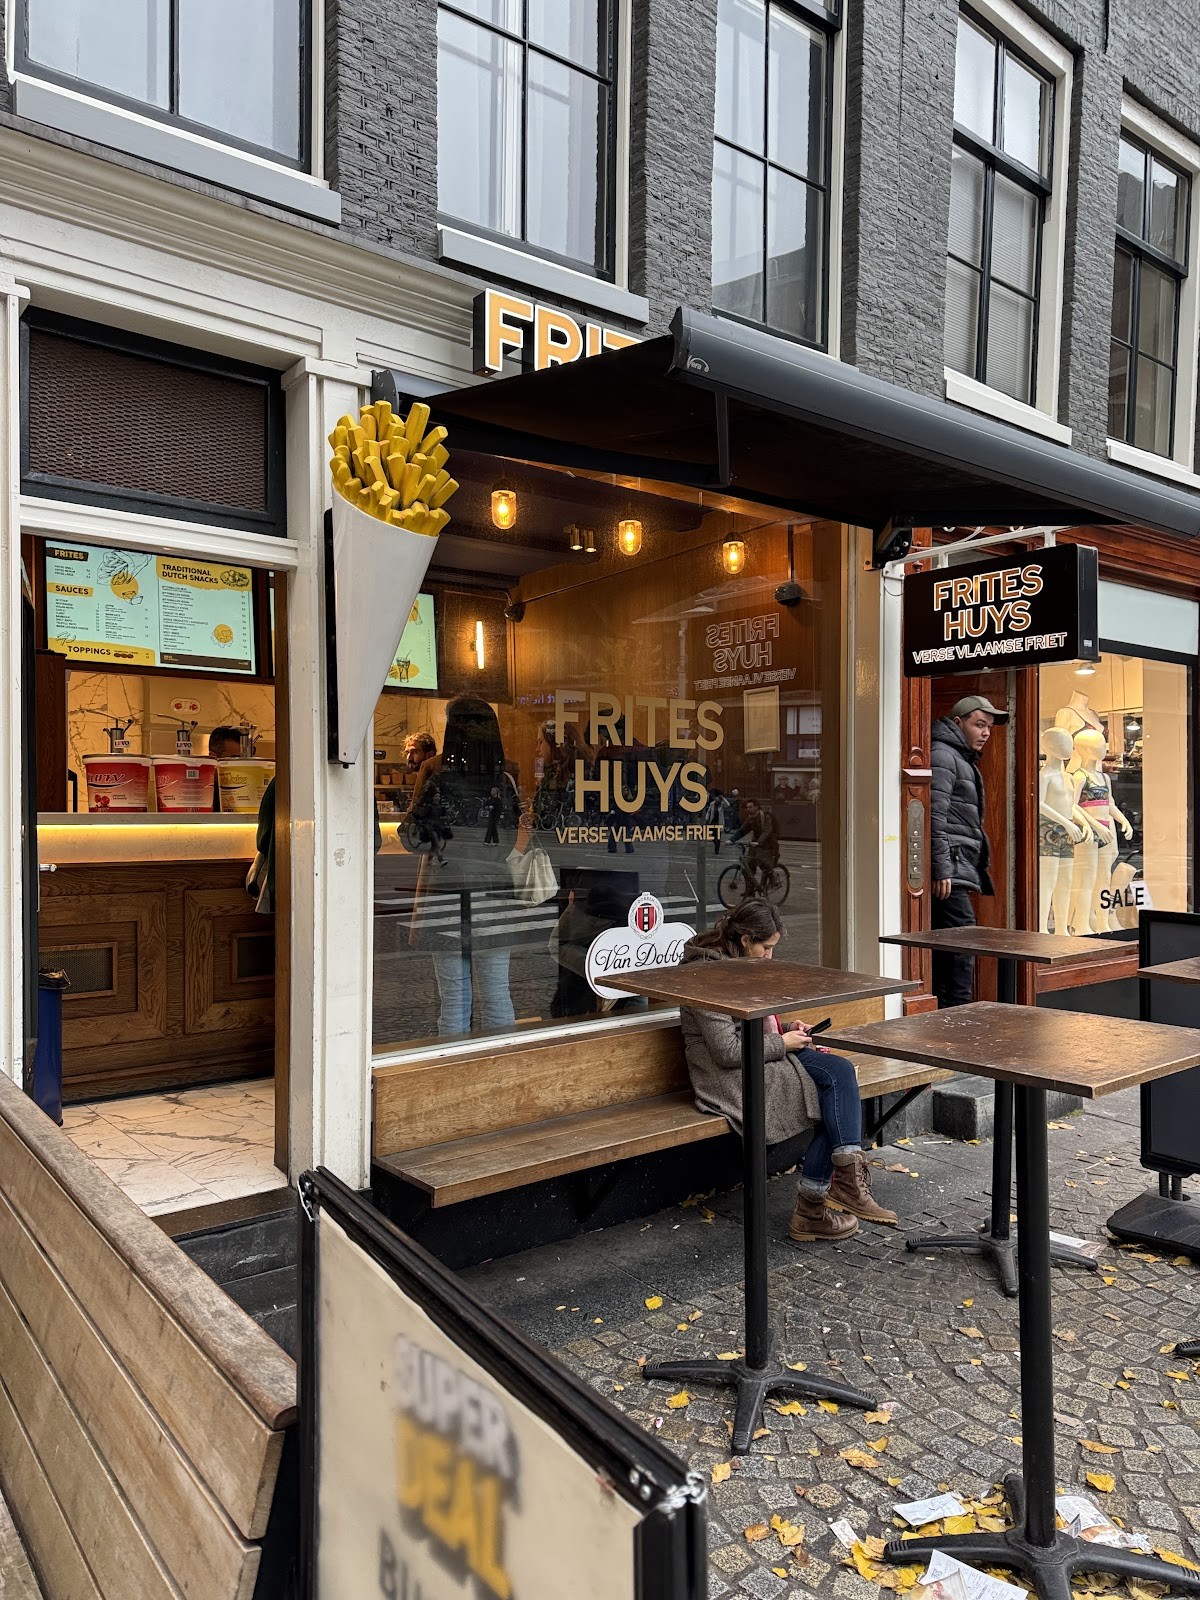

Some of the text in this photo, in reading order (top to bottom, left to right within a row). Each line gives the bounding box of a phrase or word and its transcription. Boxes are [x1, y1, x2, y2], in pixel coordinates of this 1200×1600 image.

[484, 288, 643, 372] FRI
[54, 549, 85, 560] FRITES
[161, 563, 212, 577] TRADITIONAL
[162, 571, 219, 584] DUTCH SNACKS
[55, 585, 89, 595] SAUCES
[933, 564, 1044, 611] FRITES
[943, 600, 1032, 641] HUYS
[67, 645, 111, 656] TOPPINGS
[912, 646, 955, 664] VERSE
[955, 637, 1024, 659] VLAAMSE
[1024, 632, 1068, 651] FRIET
[555, 689, 724, 751] FRITES
[574, 759, 708, 813] HUYS
[555, 824, 724, 844] VERSE VLAAMSE FRIET
[1100, 887, 1144, 909] SALE
[595, 945, 631, 972] Van
